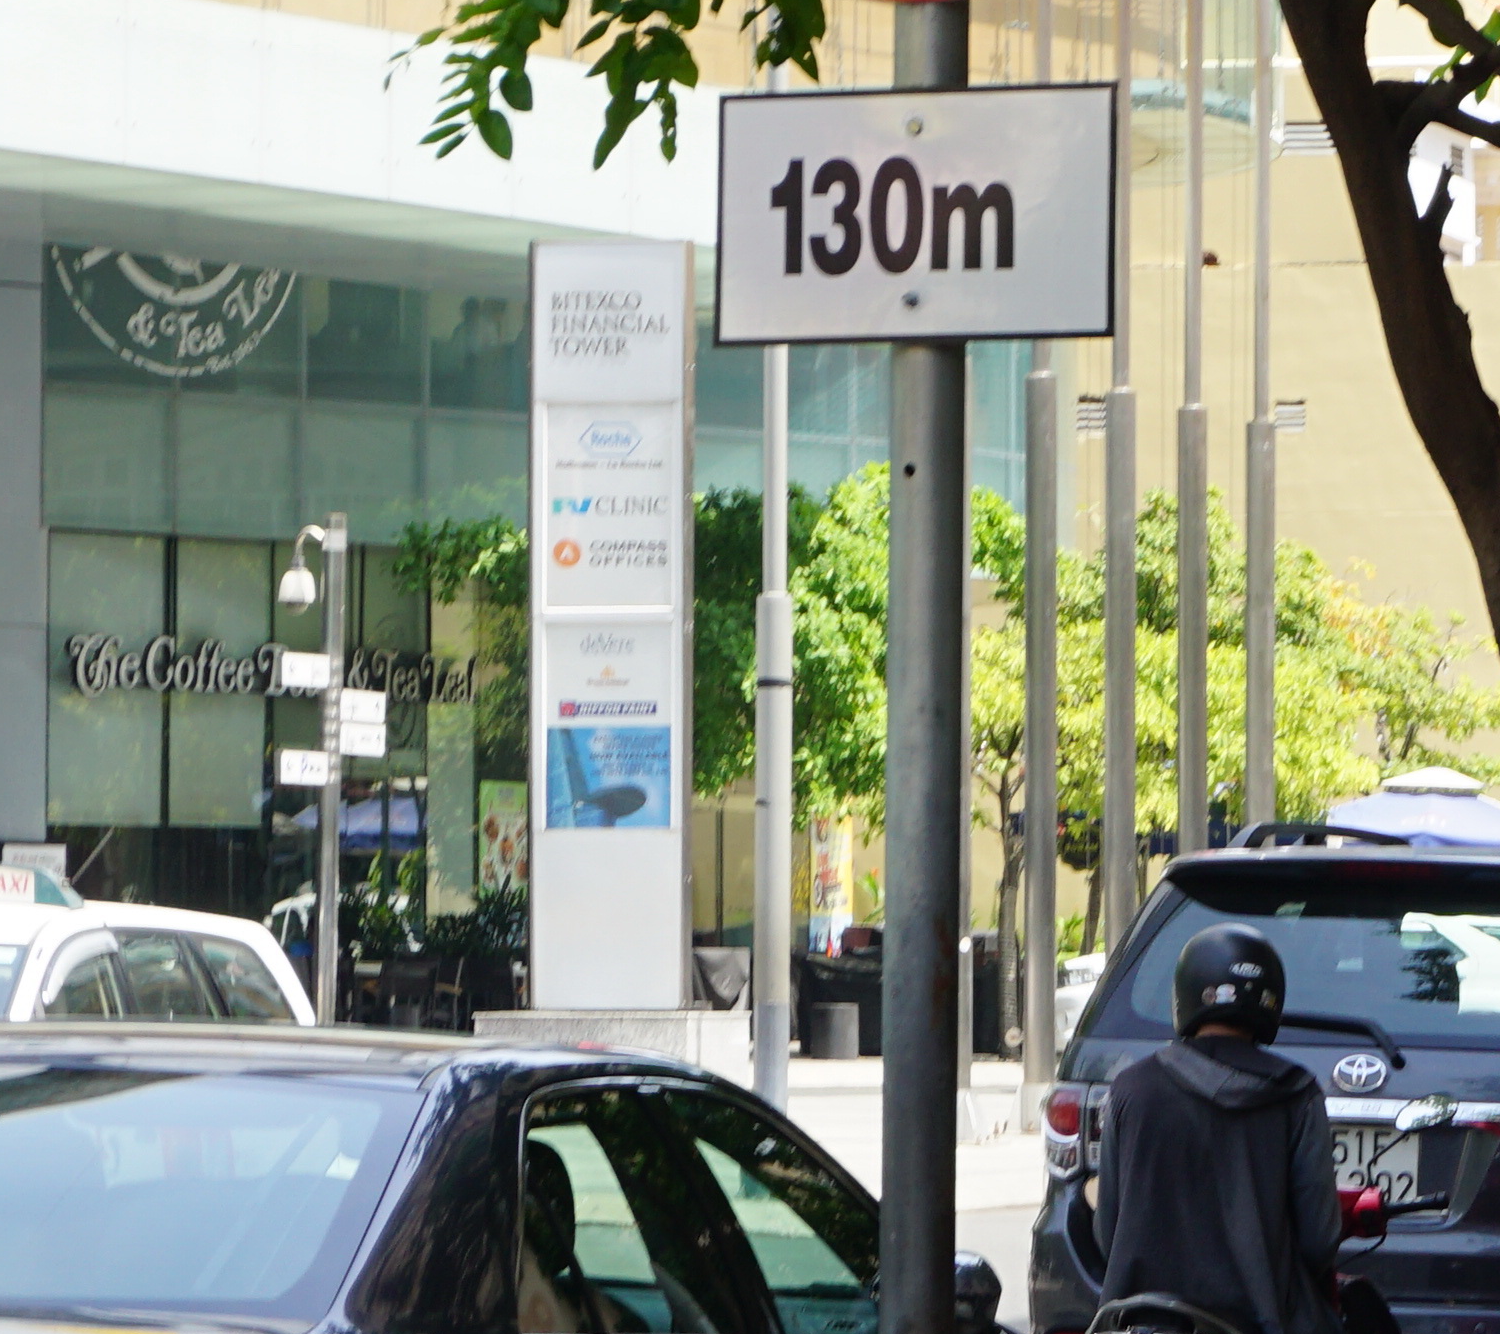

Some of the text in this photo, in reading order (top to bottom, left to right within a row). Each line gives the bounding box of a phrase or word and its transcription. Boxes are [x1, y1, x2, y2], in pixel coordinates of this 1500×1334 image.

[771, 157, 1015, 276] 130m
[222, 267, 281, 329] Lea
[550, 290, 642, 311] BITEXCO
[550, 313, 671, 335] FINANCIAL
[549, 335, 630, 357] TOWER
[594, 494, 669, 515] CLINIC
[588, 540, 668, 552] COMPASS
[588, 554, 668, 567] OFFICES
[71, 633, 141, 697] The
[146, 635, 255, 695] Coffee
[372, 648, 422, 701] Tea
